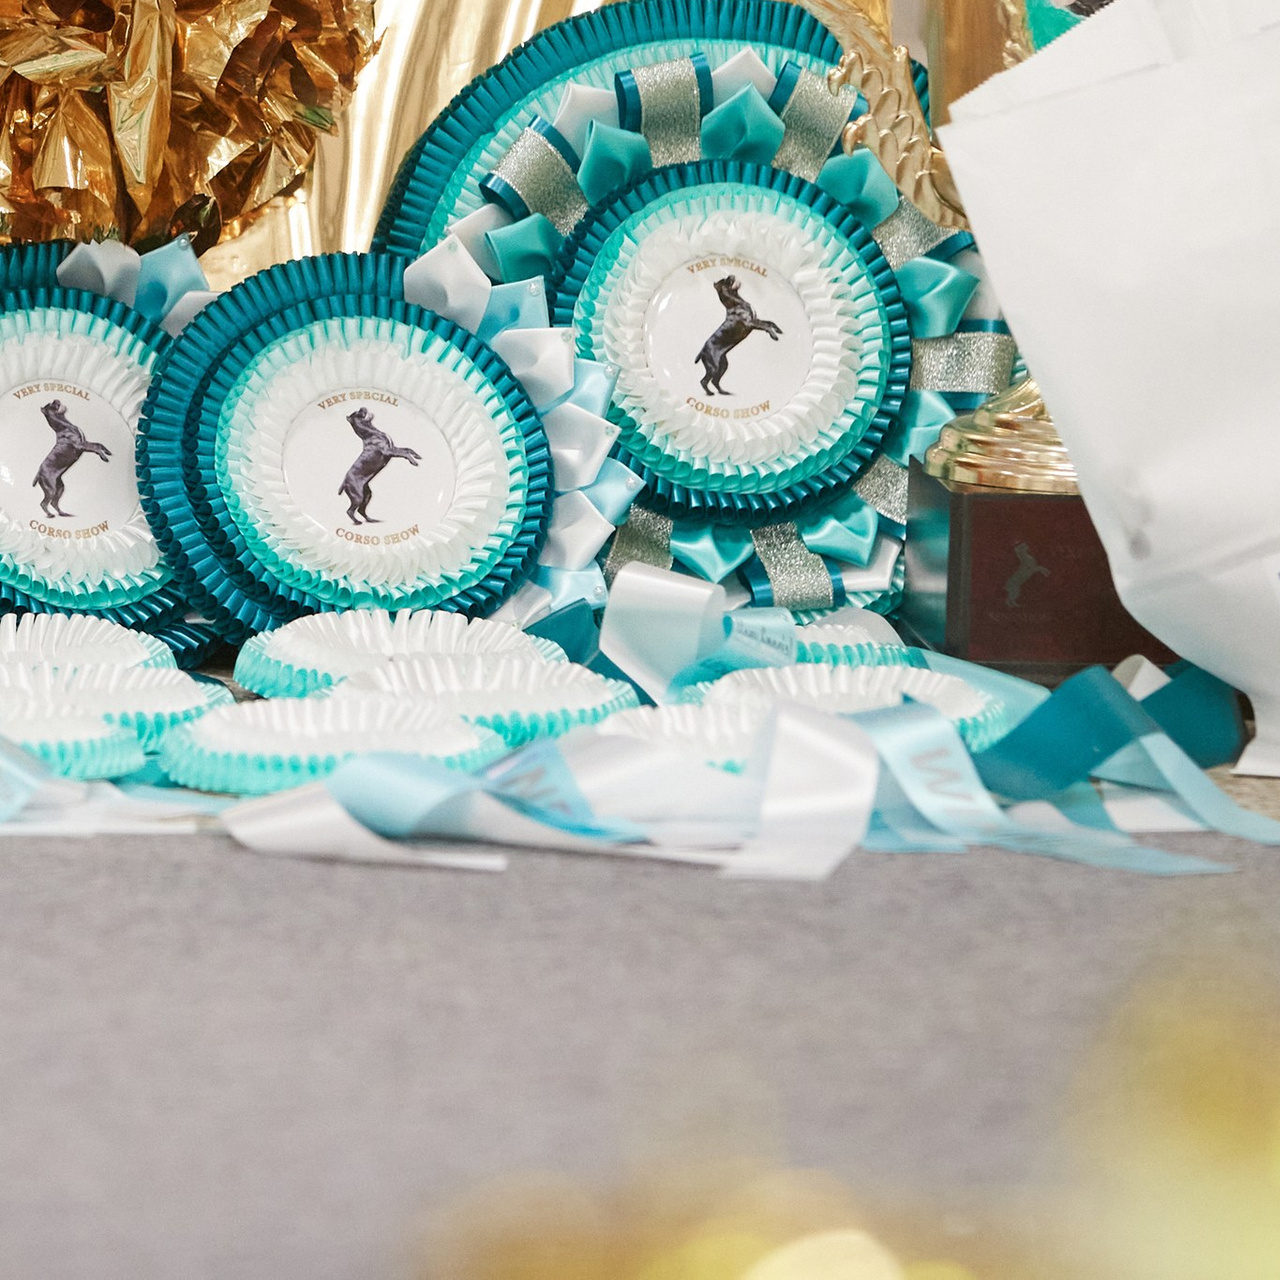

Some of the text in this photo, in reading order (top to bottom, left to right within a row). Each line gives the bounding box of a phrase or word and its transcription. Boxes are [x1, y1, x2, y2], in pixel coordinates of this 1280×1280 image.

[686, 256, 768, 278] VERY SPECIAL
[12, 382, 91, 402] VERY SPECIAL
[317, 390, 399, 411] VERY SPECIAL
[686, 396, 771, 420] CORSO SHOW
[28, 519, 111, 540] CORSO SHOW
[334, 523, 421, 546] CORSO SHOW
